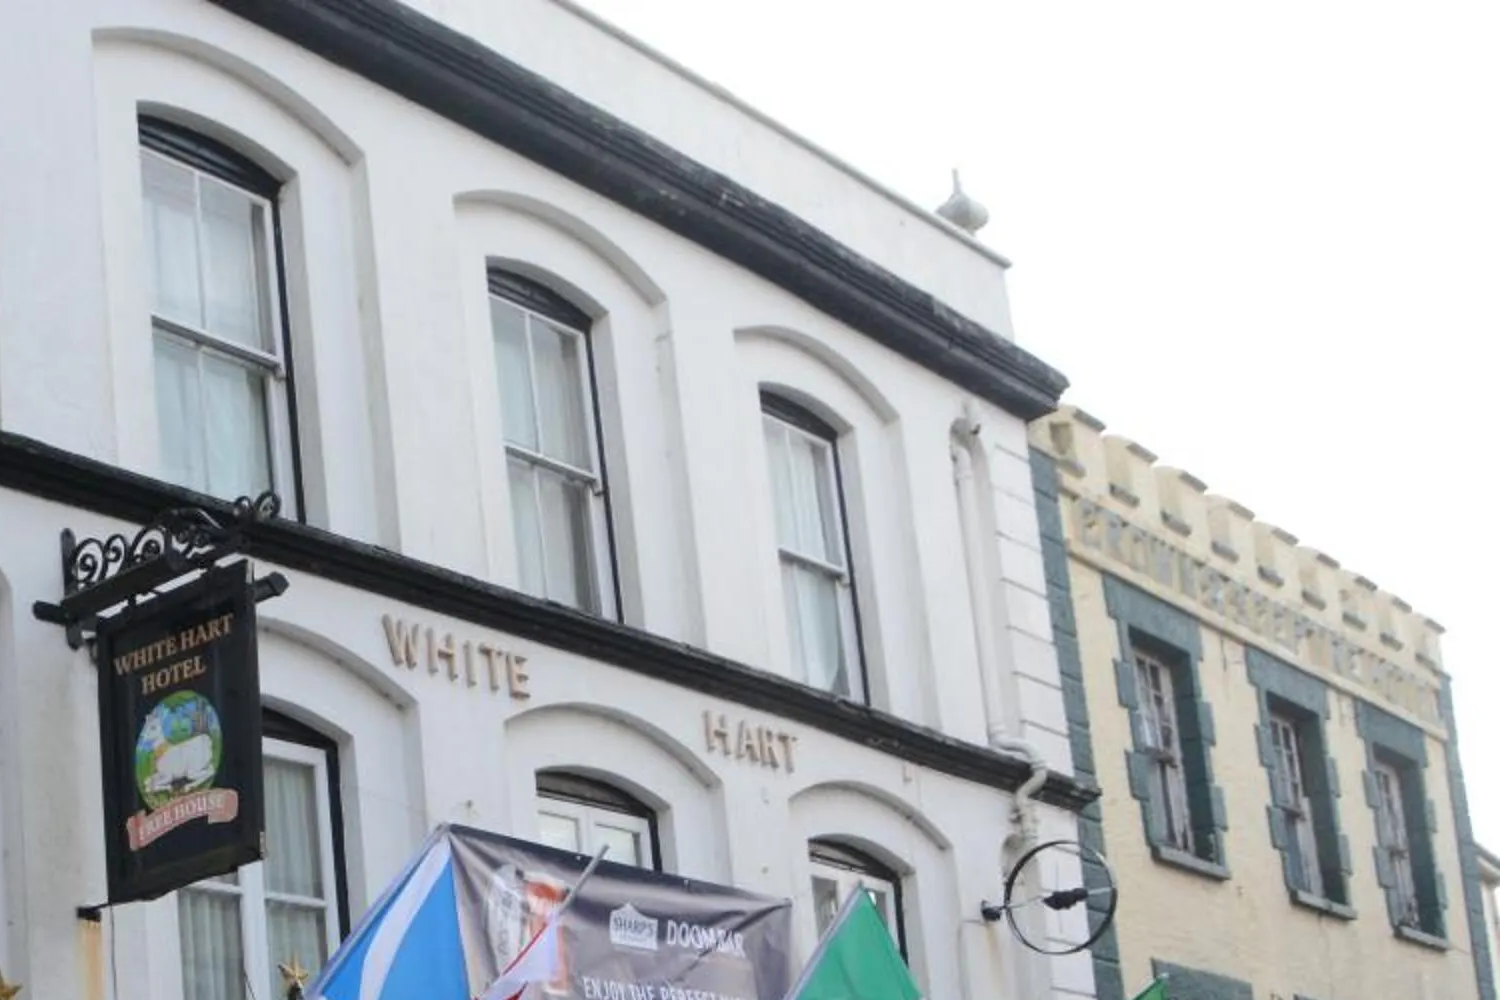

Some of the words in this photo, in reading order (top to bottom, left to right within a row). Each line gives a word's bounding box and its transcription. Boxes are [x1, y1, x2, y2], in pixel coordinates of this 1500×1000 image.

[112, 638, 176, 676] WHITE
[180, 612, 234, 652] HART
[140, 655, 208, 695] HOTEL
[381, 612, 531, 699] WHITE
[704, 709, 799, 775] HART
[137, 808, 173, 842] FREE
[174, 796, 226, 823] HOUSE
